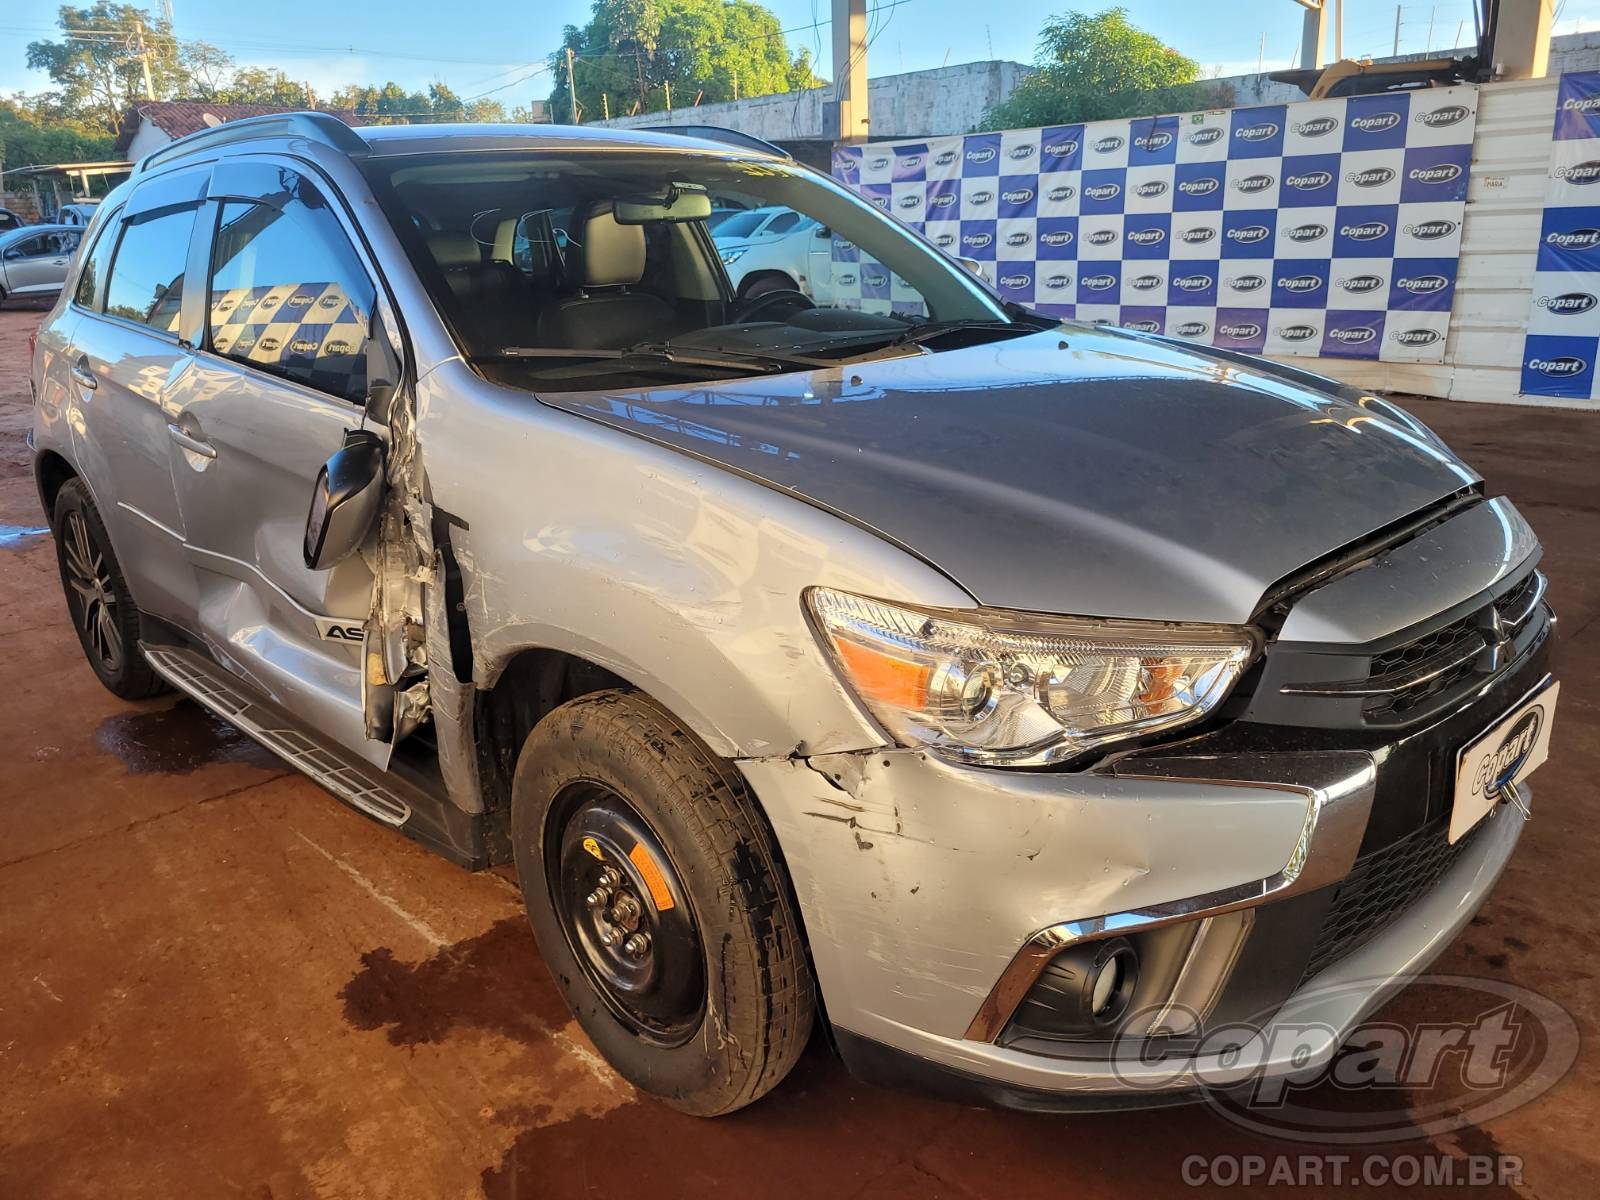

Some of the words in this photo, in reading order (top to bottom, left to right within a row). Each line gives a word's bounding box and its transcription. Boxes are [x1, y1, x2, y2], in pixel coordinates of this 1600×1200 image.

[1563, 98, 1600, 111] Copa
[1414, 107, 1462, 122] Copart
[1291, 120, 1332, 133] Copart
[1351, 115, 1394, 129] Copart
[1235, 125, 1273, 139] Copart
[967, 148, 992, 160] Copart
[1045, 142, 1074, 155] Copart
[1345, 170, 1391, 184] Copart
[1409, 167, 1455, 180] Copart
[1178, 180, 1214, 192] Copart
[1286, 174, 1326, 187] Copart
[1001, 190, 1029, 202] Copart
[1084, 185, 1116, 198] Copart
[1227, 227, 1265, 240] Copart
[1281, 226, 1321, 238] Copart
[1340, 224, 1383, 237] Copart
[1403, 222, 1449, 235] Copart
[963, 233, 989, 245] Copart
[1040, 231, 1069, 244] Copart
[1127, 230, 1160, 242] Copart
[1547, 232, 1599, 245] Copart
[1000, 275, 1027, 287] Copart
[1081, 275, 1110, 288] Copart
[1173, 276, 1206, 289] Copart
[1277, 277, 1317, 290] Copart
[1335, 276, 1377, 290] Copart
[1397, 277, 1442, 290] Copart
[1537, 295, 1589, 310] Copart
[1220, 324, 1256, 337] Copart
[1329, 328, 1371, 341] Copart
[1390, 331, 1435, 344] Copart
[1529, 358, 1581, 373] Copart
[326, 625, 364, 641] AS
[1471, 712, 1538, 795] Copart
